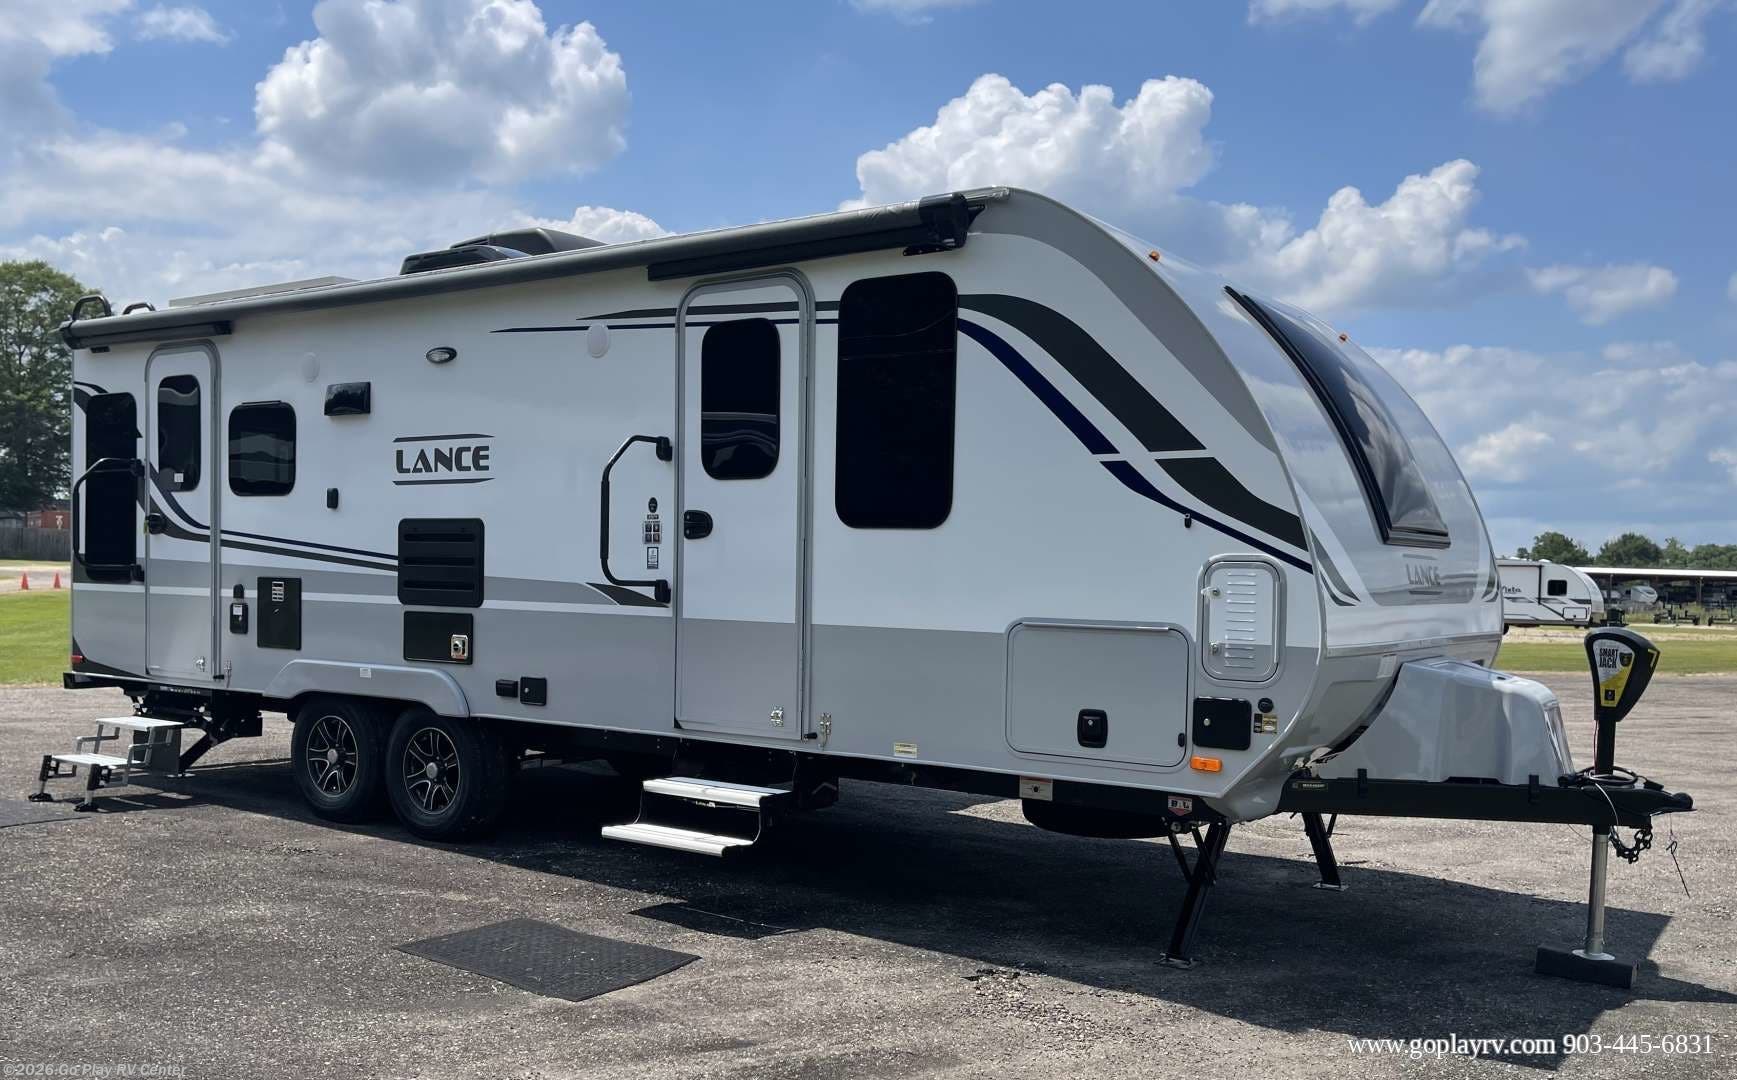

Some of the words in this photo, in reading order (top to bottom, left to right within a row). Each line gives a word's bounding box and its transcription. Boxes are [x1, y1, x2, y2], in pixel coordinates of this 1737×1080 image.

[396, 445, 490, 474] LANCE
[1405, 563, 1442, 588] LANCE
[1599, 648, 1618, 658] SMART
[1599, 656, 1617, 669] JACK
